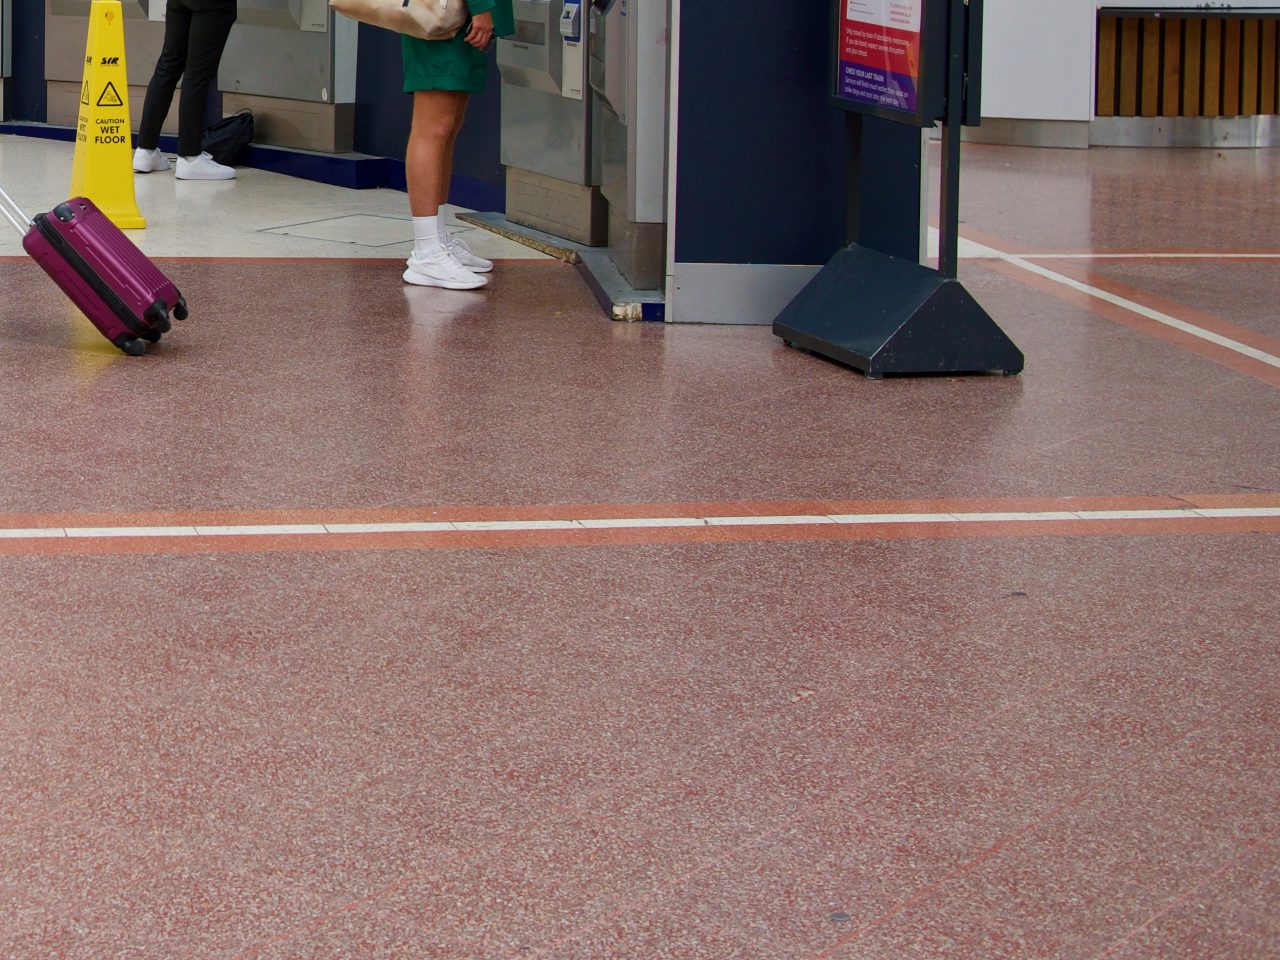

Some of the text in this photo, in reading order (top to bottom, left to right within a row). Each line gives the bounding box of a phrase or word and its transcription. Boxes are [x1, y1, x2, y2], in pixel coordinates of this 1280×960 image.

[101, 56, 120, 65] SIR
[100, 125, 120, 134] WET
[94, 135, 126, 144] FLOOR
